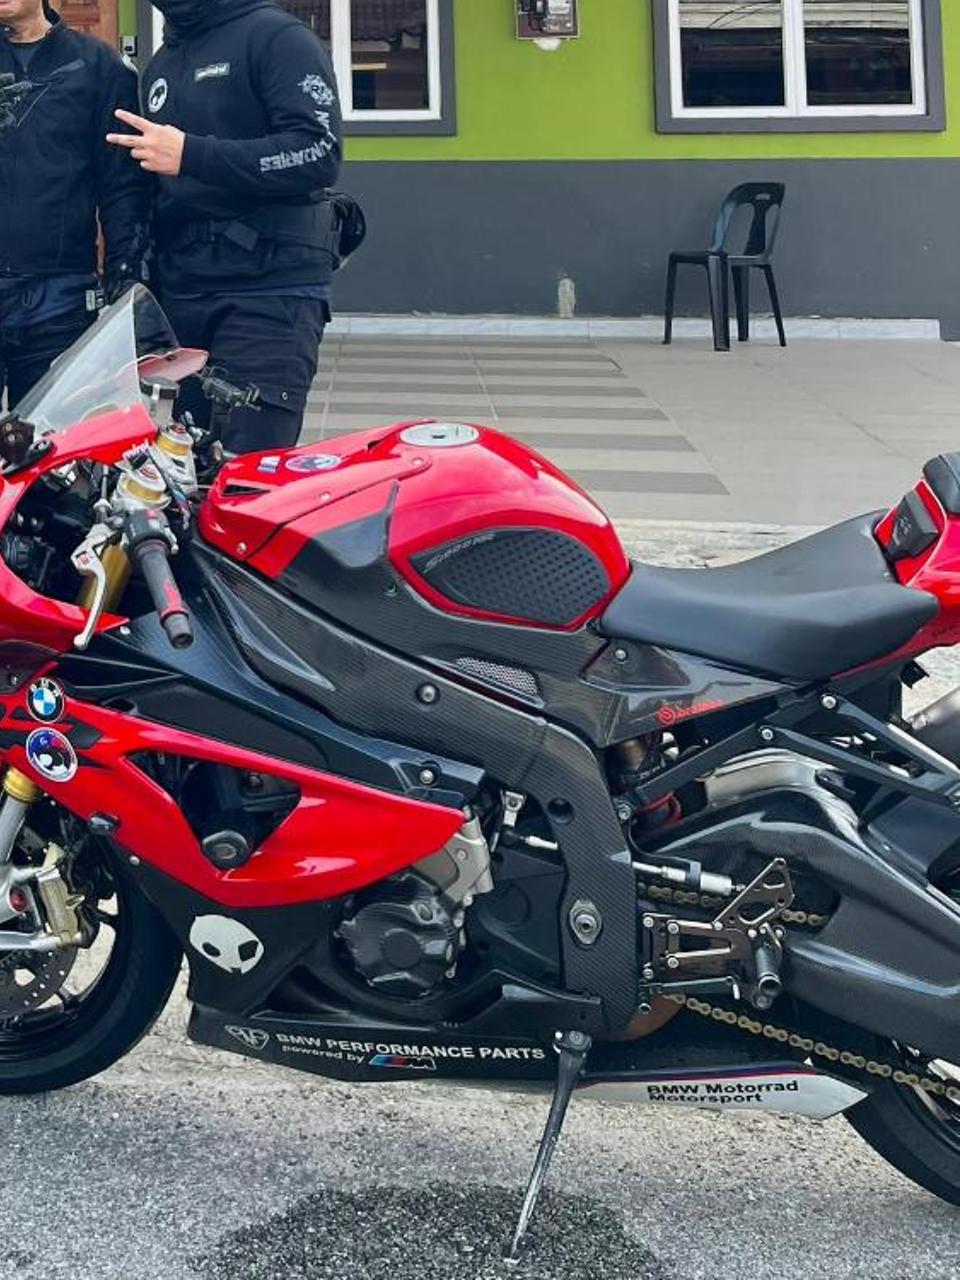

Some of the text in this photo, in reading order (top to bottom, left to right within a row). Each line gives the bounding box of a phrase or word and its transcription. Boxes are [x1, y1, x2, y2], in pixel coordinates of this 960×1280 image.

[276, 1032, 321, 1048] BMW
[326, 1037, 475, 1059] PERFORMANCE
[479, 1046, 546, 1060] PARTS
[346, 1051, 365, 1065] by
[647, 1080, 799, 1095] BMW Motorrad
[648, 1093, 763, 1104] Motorsport
